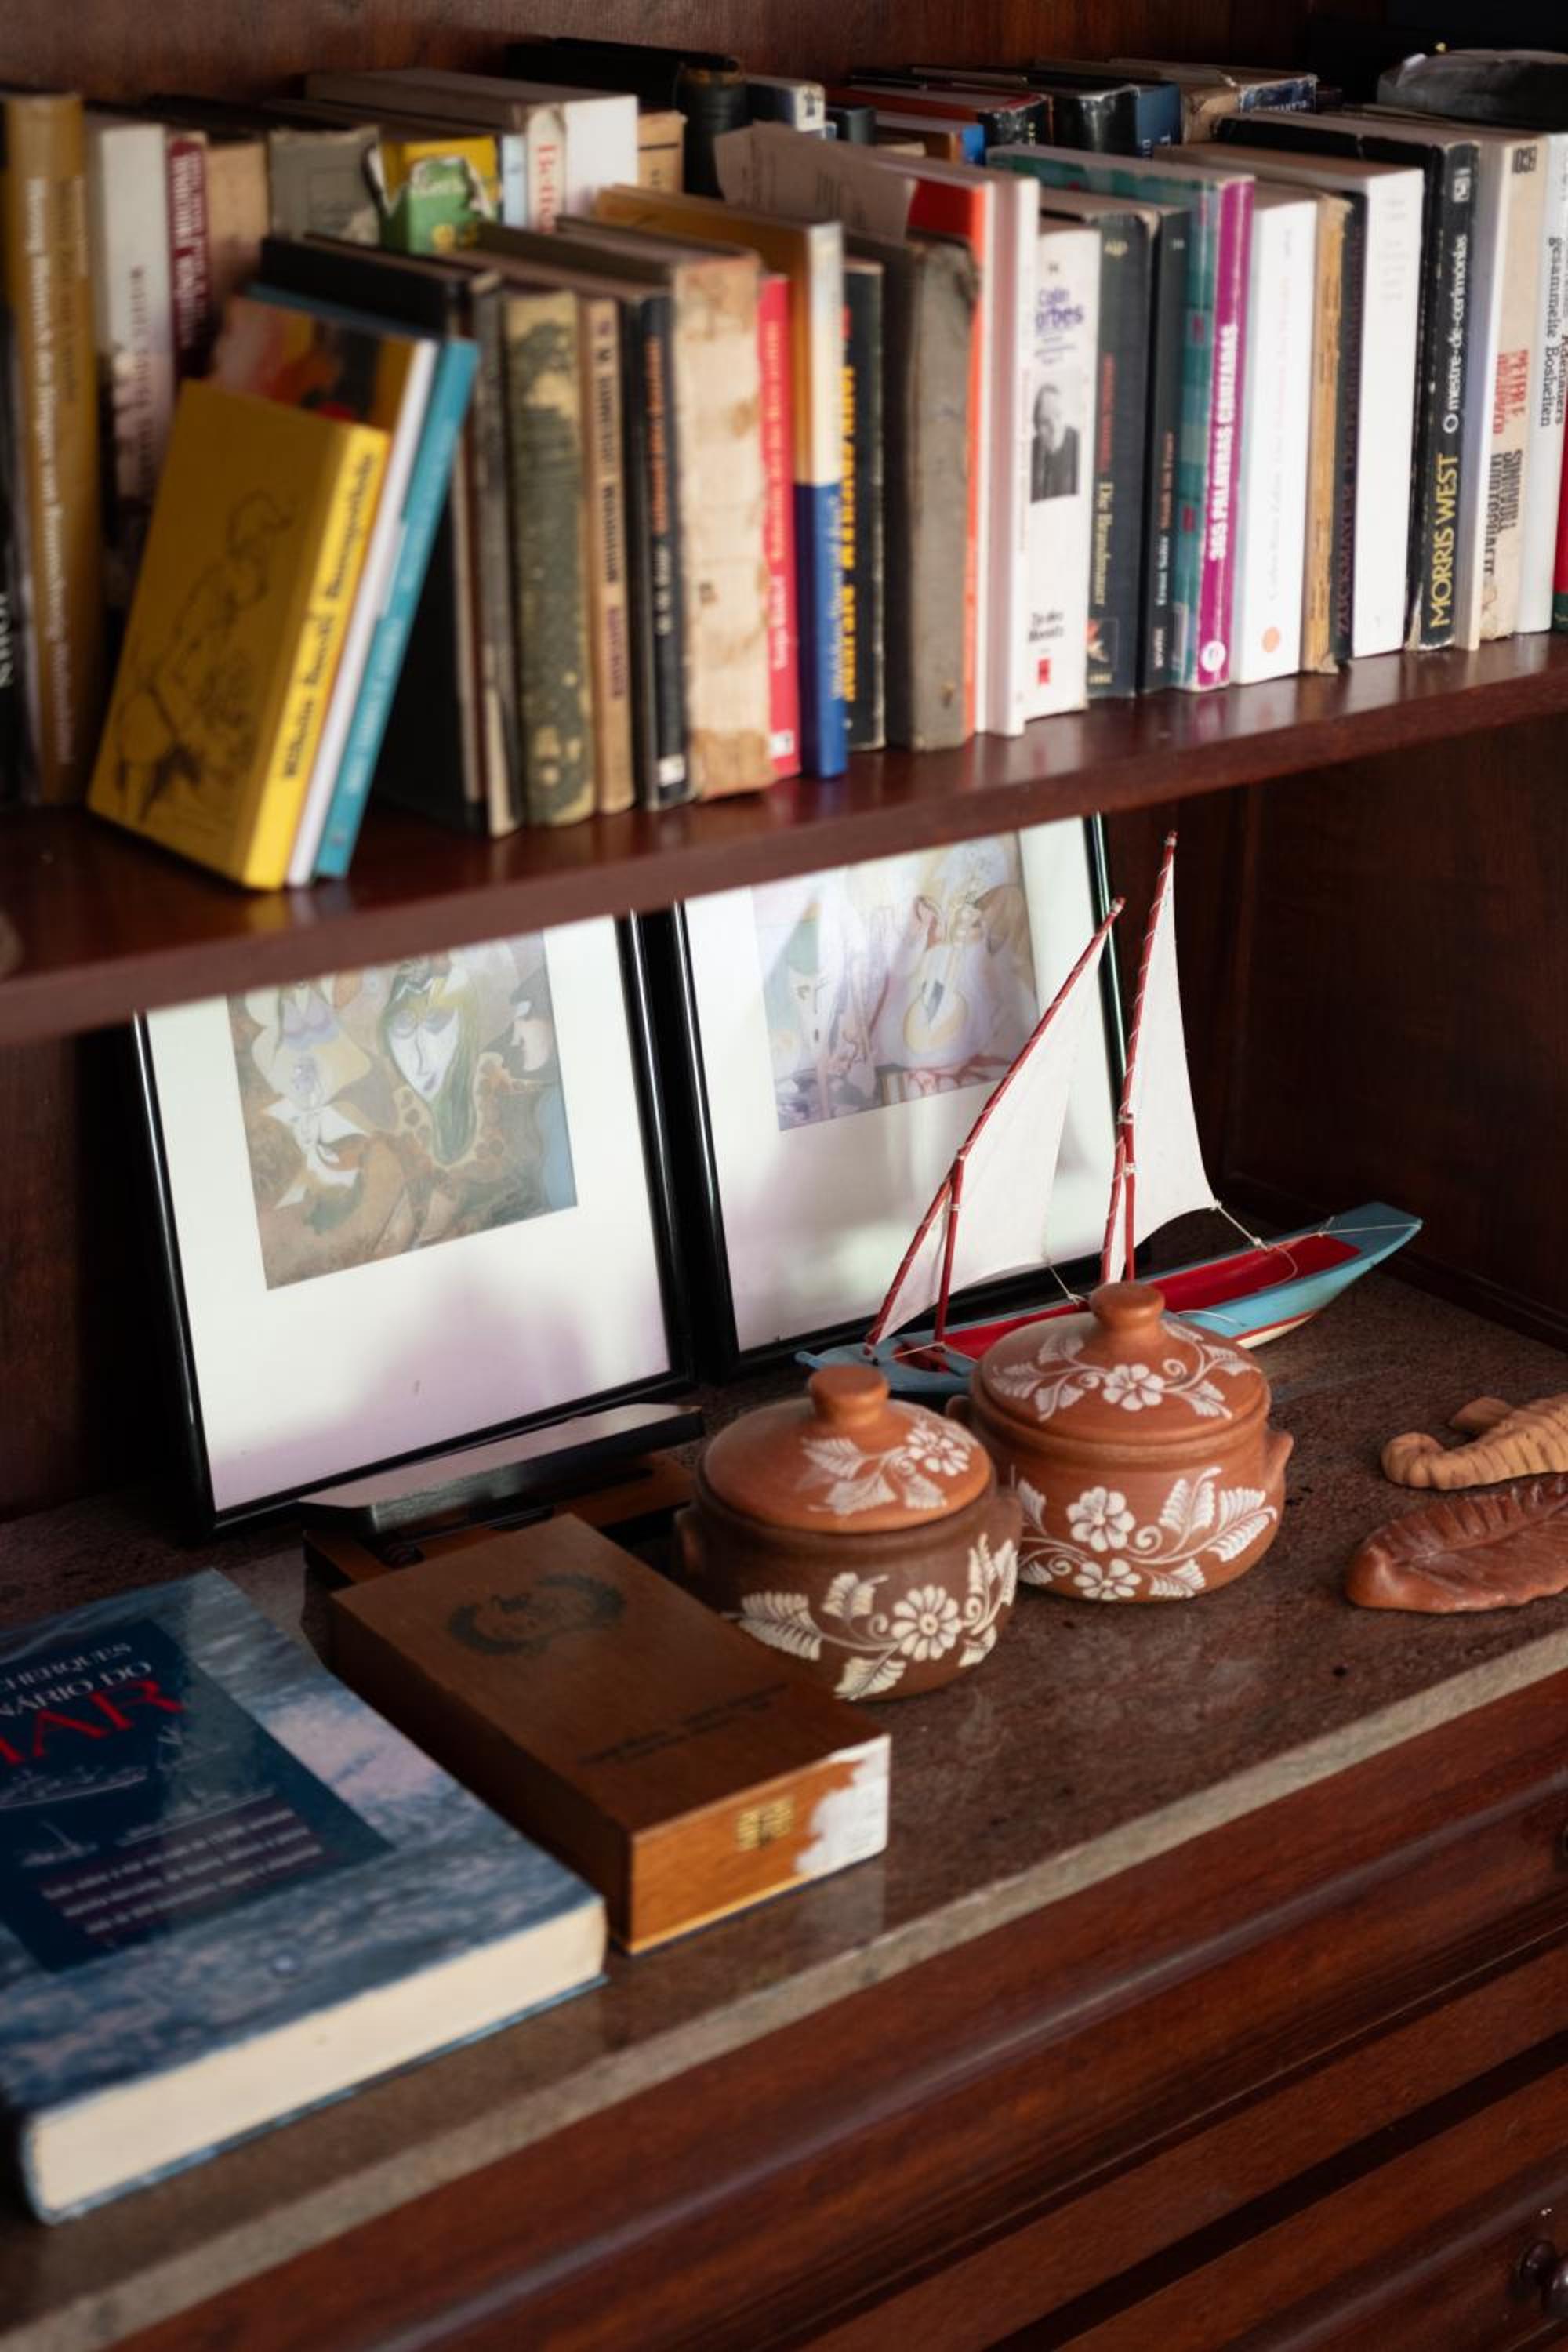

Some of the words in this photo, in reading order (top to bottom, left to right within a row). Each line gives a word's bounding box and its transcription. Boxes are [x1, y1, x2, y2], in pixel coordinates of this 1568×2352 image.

[1035, 305, 1086, 333] orbes
[1448, 234, 1467, 410] mestre-de-cerimónias
[1547, 236, 1563, 338] gesammelte
[1216, 324, 1239, 423] CRUZADAS
[1509, 349, 1529, 403] PETER
[1540, 346, 1559, 427] Bosheiten
[1443, 413, 1459, 433] O
[1098, 481, 1114, 509] Die
[1211, 426, 1234, 519] PALAVRAS
[1436, 452, 1459, 527] WEST
[1497, 448, 1523, 533] SINNVOLL
[1094, 512, 1113, 606] Brandmauer
[1209, 521, 1229, 561] 365
[1429, 525, 1454, 628] MORRIS
[98, 1660, 152, 1687] DO
